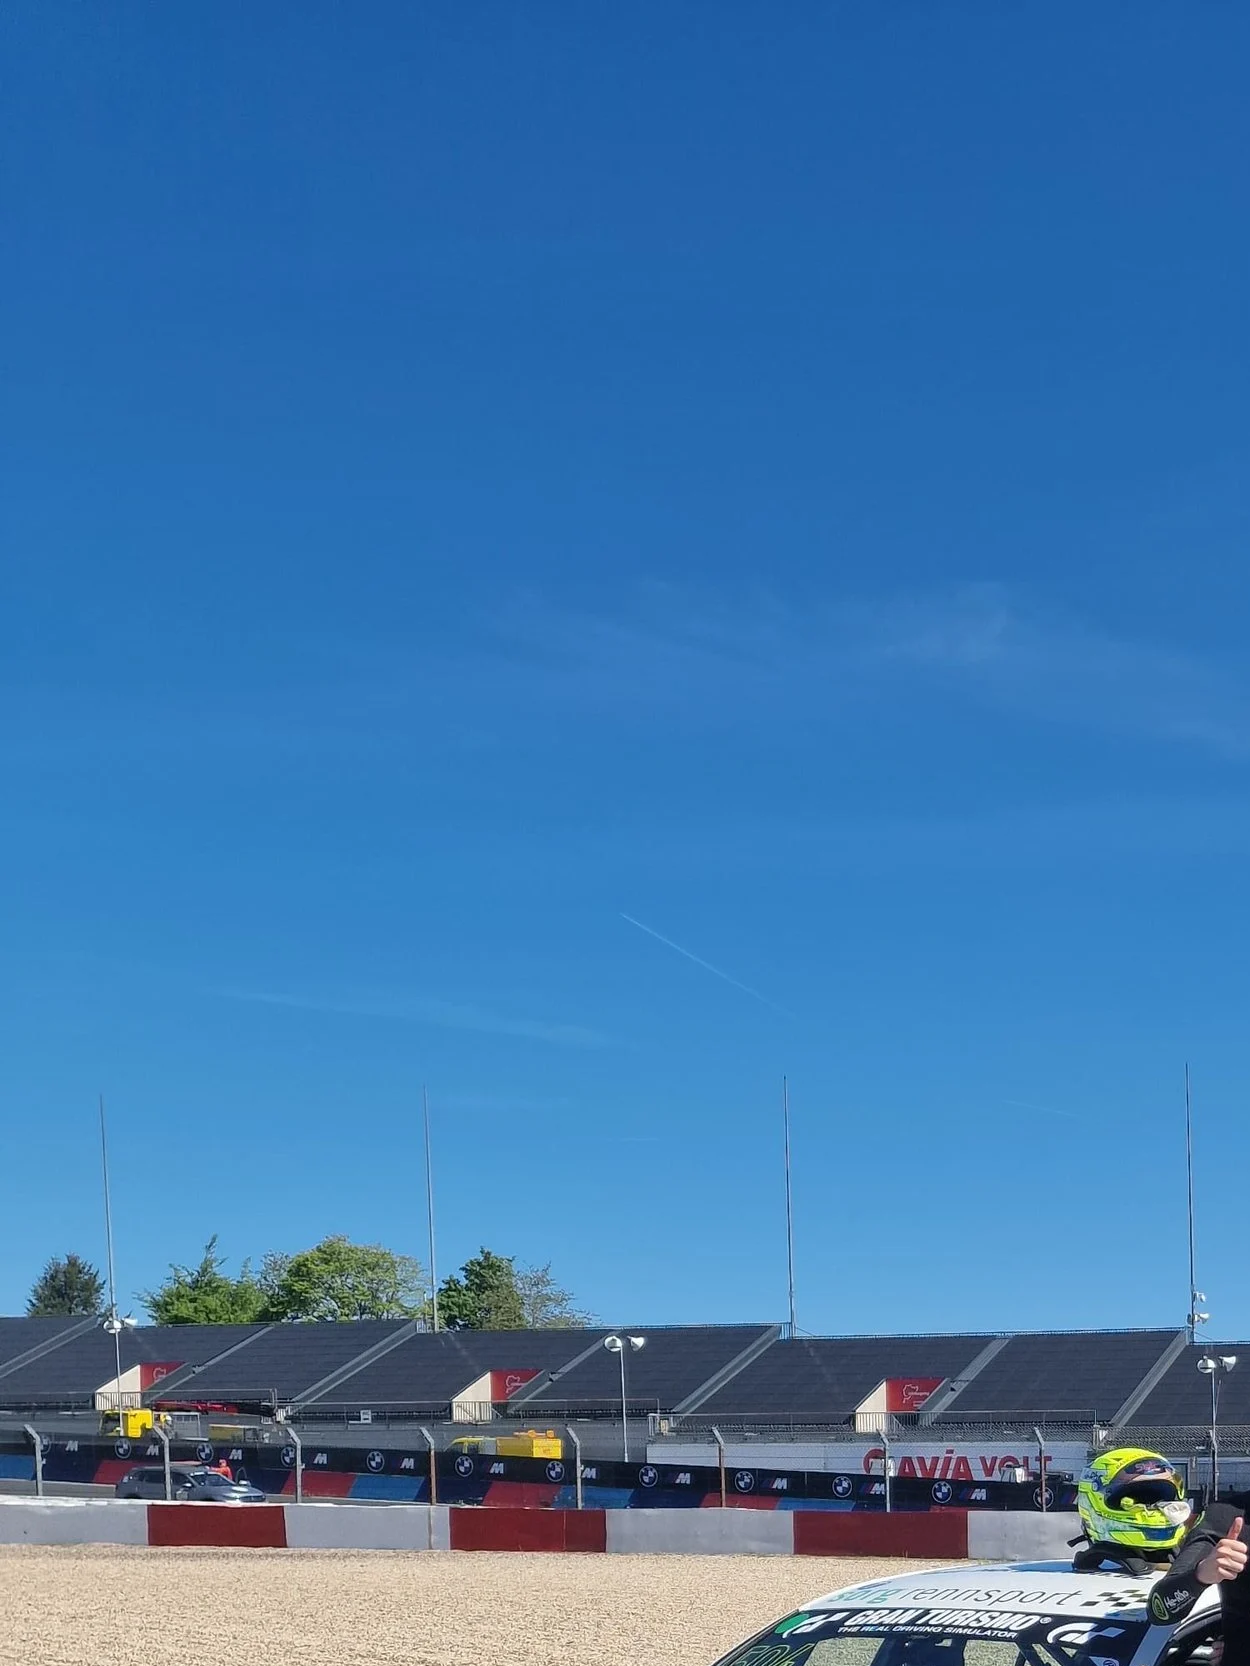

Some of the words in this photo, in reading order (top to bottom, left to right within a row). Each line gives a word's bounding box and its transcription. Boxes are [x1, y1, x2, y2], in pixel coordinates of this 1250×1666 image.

[901, 1585, 1083, 1607] rennsport
[844, 1609, 923, 1627] GRAN
[837, 1626, 859, 1634] THE
[860, 1625, 888, 1634] REAL
[890, 1625, 944, 1635] DRIVING
[948, 1627, 1019, 1639] SIMULATOR
